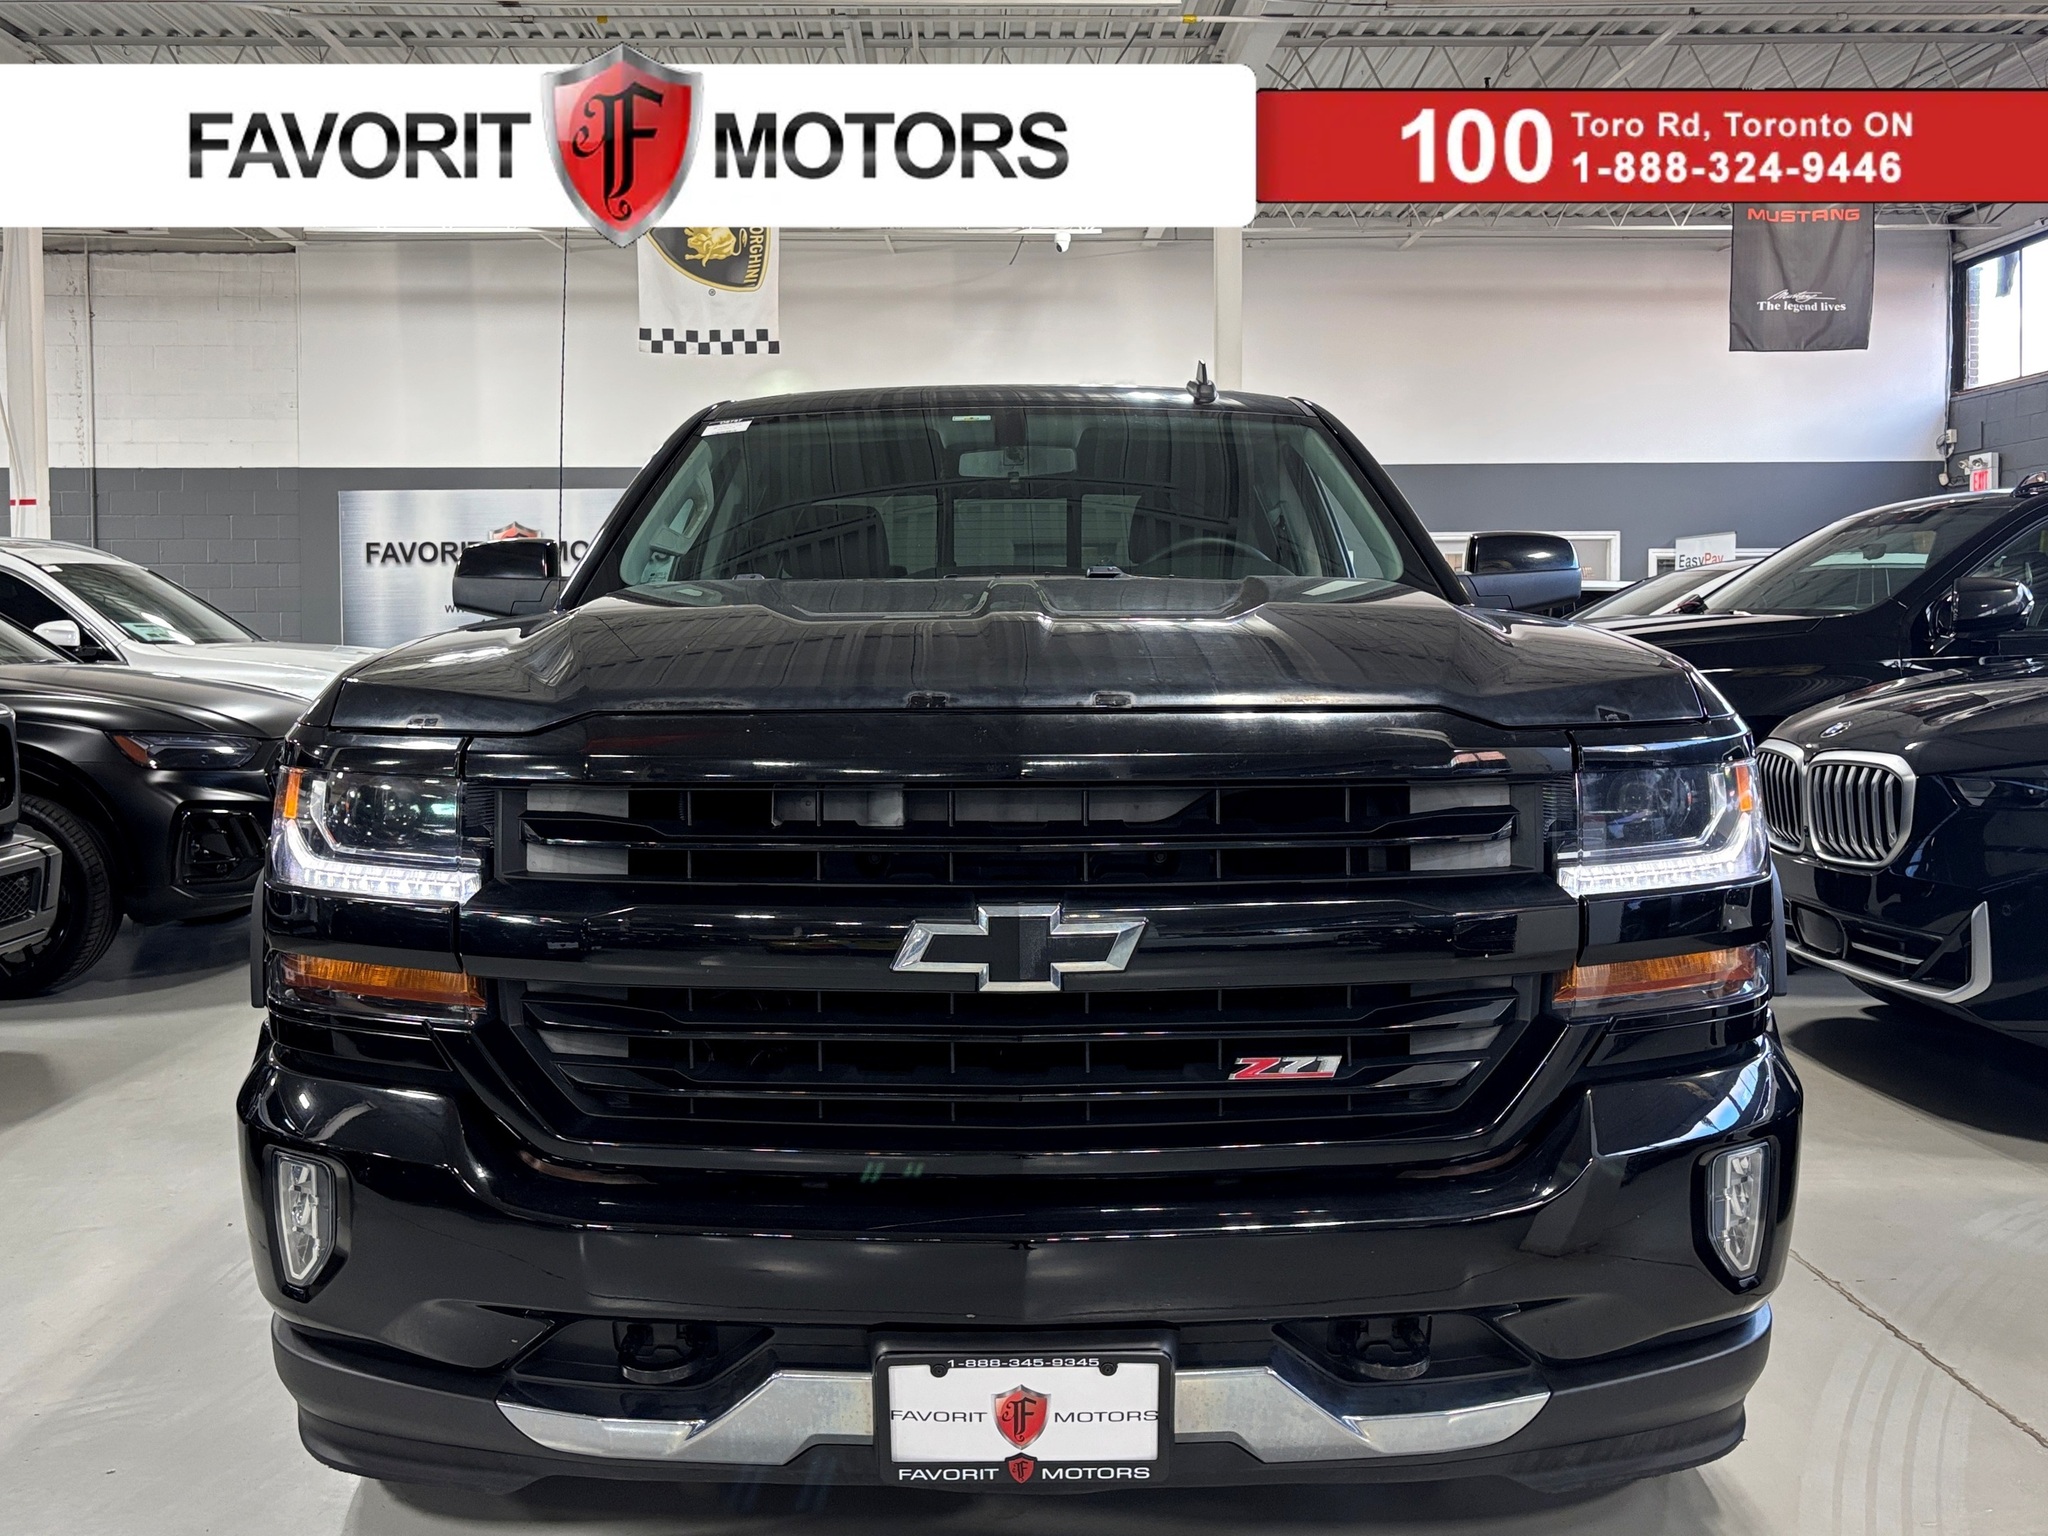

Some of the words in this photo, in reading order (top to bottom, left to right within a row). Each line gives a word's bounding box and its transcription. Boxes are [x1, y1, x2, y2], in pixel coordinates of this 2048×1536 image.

[1747, 208, 1860, 222] MUSTANG
[744, 227, 764, 284] ORGHINI
[1757, 301, 1781, 311] The
[1784, 301, 1818, 313] legend
[1820, 302, 1847, 312] lives
[365, 541, 478, 563] FAVORI
[1228, 1055, 1342, 1080] Z71
[947, 1358, 1099, 1368] 1-888-345-9345
[891, 1410, 988, 1423] FAVORIT
[1054, 1410, 1159, 1423] MOTORS
[898, 1468, 999, 1481] FAVORIT
[1042, 1467, 1150, 1480] MOTORS
